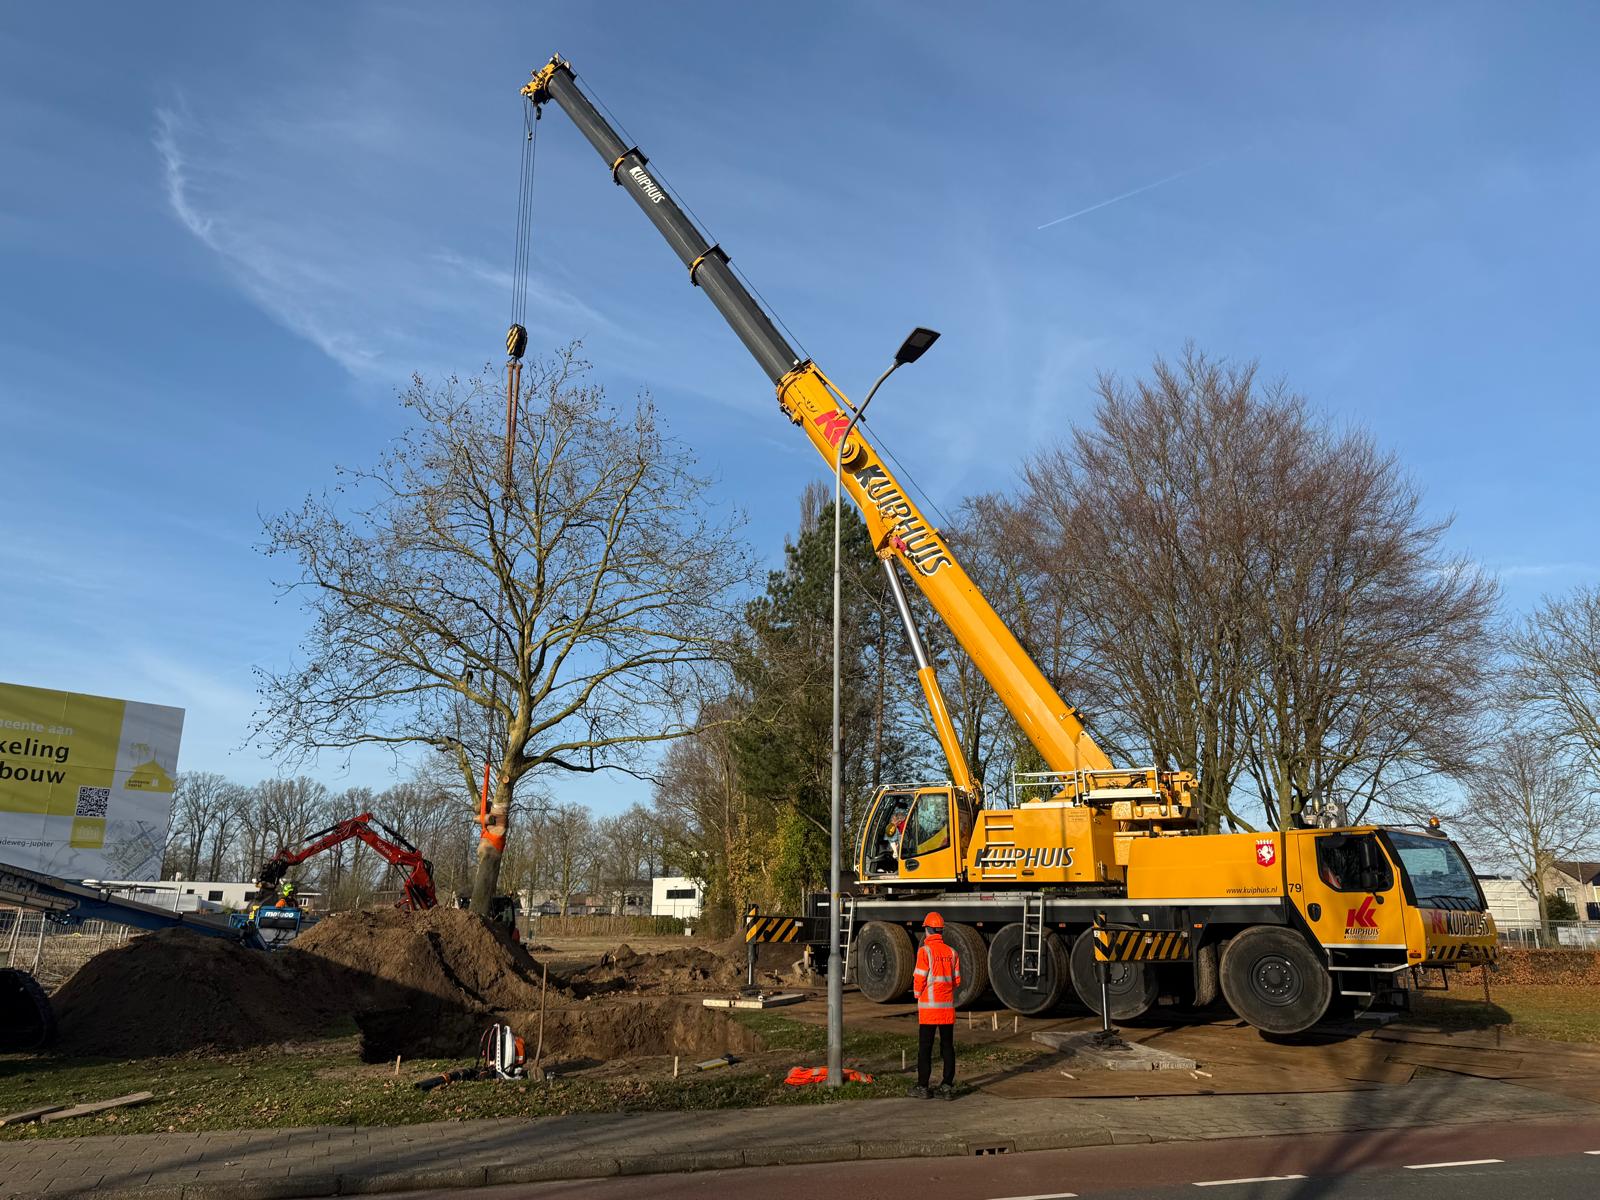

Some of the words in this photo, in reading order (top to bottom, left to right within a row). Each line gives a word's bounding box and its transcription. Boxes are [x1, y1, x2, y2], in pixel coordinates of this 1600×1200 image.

[629, 166, 665, 204] KUIPHUIS
[854, 464, 952, 576] KUIPHUIS
[0, 719, 44, 733] eente
[48, 725, 73, 736] aan
[0, 760, 66, 784] bouw
[0, 838, 54, 848] deweg-jupiter
[974, 847, 1076, 869] KUIPHUIS
[1226, 885, 1278, 895] www.kuiphuis.nl
[1288, 883, 1302, 893] 79
[1345, 928, 1380, 936] KUIPHUIS
